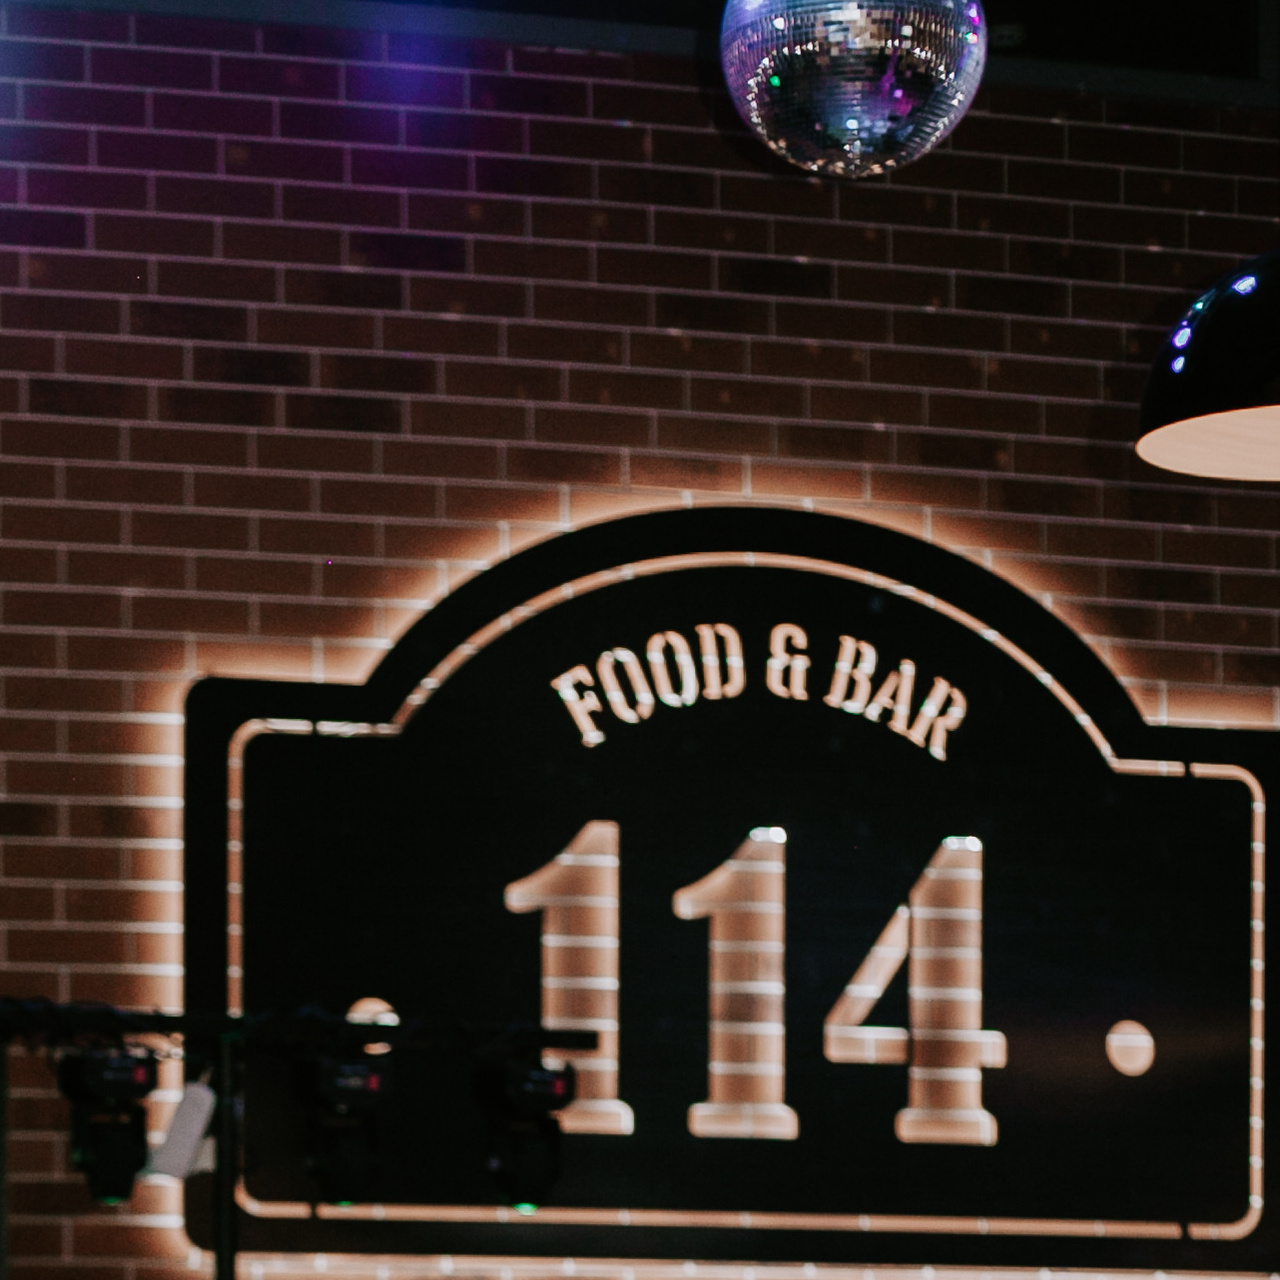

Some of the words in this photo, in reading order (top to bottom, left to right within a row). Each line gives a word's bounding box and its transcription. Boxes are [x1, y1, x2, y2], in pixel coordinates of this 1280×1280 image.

[550, 622, 747, 748] FOOD
[765, 622, 812, 701] &
[822, 634, 968, 762] BAR
[503, 819, 1009, 1147] 114
